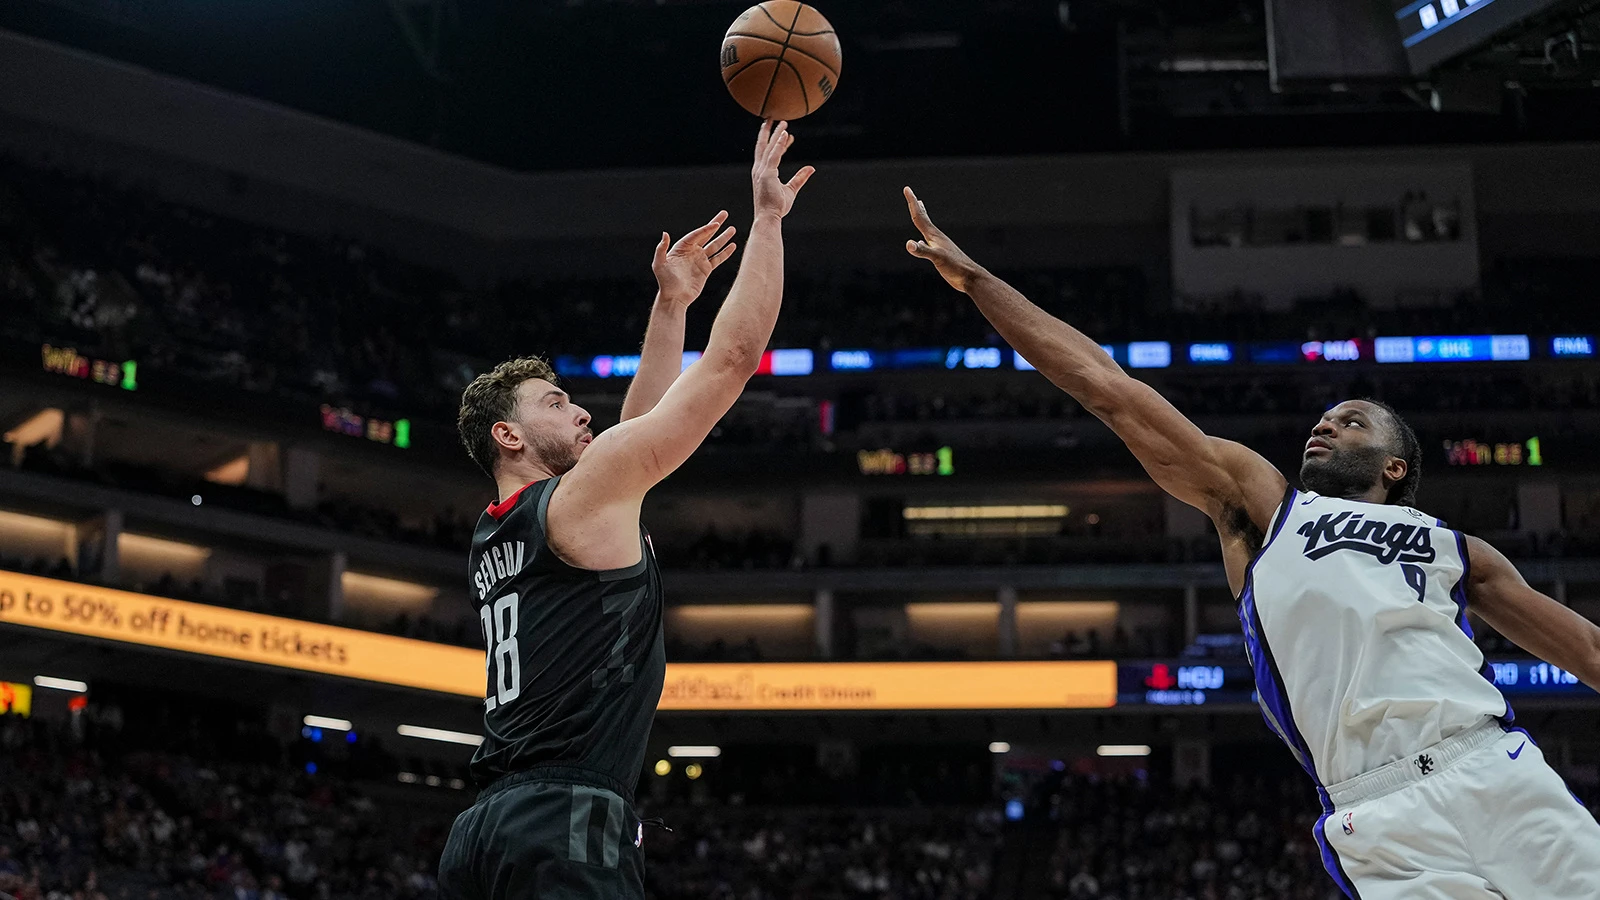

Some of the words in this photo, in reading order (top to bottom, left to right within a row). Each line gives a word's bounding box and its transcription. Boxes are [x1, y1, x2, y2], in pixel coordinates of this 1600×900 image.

[1553, 337, 1591, 354] FINAL
[1526, 436, 1542, 465] 1
[1297, 511, 1436, 564] Kings
[474, 541, 525, 601] SENGUN
[1400, 563, 1426, 603] 9
[26, 588, 52, 616] to
[63, 594, 121, 629] 50%
[130, 608, 171, 634] off
[179, 614, 250, 647] home
[261, 628, 347, 664] tickets
[480, 592, 520, 714] 28
